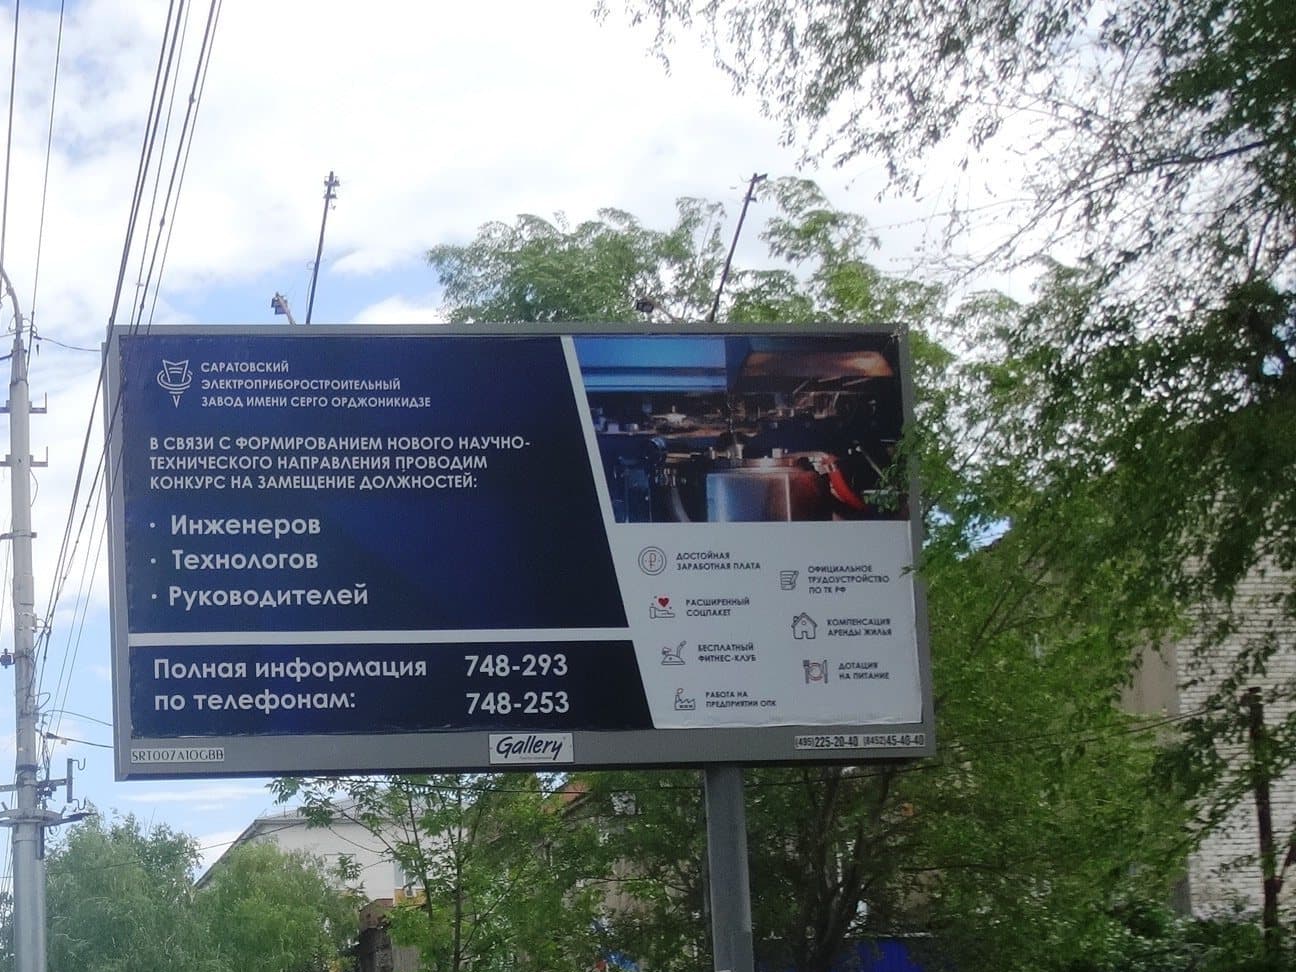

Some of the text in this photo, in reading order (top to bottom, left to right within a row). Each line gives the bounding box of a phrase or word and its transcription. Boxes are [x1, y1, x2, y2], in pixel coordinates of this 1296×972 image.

[200, 360, 289, 373] САРАТОВСКИЙ
[201, 377, 401, 391] ЭЛЕКТРОПРИБОРОСТРОИТЕЛЬНЫЙ
[201, 396, 432, 409] ЗАВОД ИМЕНИ СЕРГО ОРДЖОНИКИДЗЕ
[150, 436, 531, 451] В СВЯЗИ С ФОРМИРОВАНИЕМ НОВОГО НАУЧНО-
[150, 455, 488, 471] ТЕХНИЧЕСКОГО НАПРАВЛЕНИЯ ПРОВОДИМ
[150, 472, 478, 491] КОНКУРС НА ЗАМЕЩЕНИЕ ДОЛЖНОСТЕЙ:
[171, 515, 321, 538] Инженеров
[172, 550, 318, 571] Технологов
[676, 551, 730, 561] ДОСТОЙНАЯ
[677, 562, 761, 571] ЗАРАБОТНАЯ ПЛАТА
[808, 564, 873, 574] ОФИЦИАЛЬНОЕ
[808, 574, 890, 584] ТРУДОУСТРОЙСТВО
[809, 586, 822, 594] ПО
[169, 584, 369, 611] Руководителей
[686, 597, 750, 607] РАСШИРЕННЫЙ
[686, 608, 731, 617] СОЦПАКЕТ
[827, 618, 891, 626] КОМПЕНСАЦИЯ
[828, 629, 861, 637] АРЕНДЫ
[698, 642, 754, 652] БЕСПЛАТНЫЙ
[698, 654, 757, 663] ФИТНЕС-КЛУБ
[154, 654, 568, 680] Полная информация 748-293
[838, 662, 879, 671] ДОТАЦИЯ
[853, 672, 890, 680] ПИТАНИЕ
[705, 691, 735, 699] РАБОТА
[154, 689, 570, 715] по телефонам: 748-253
[495, 735, 563, 761] Gallery
